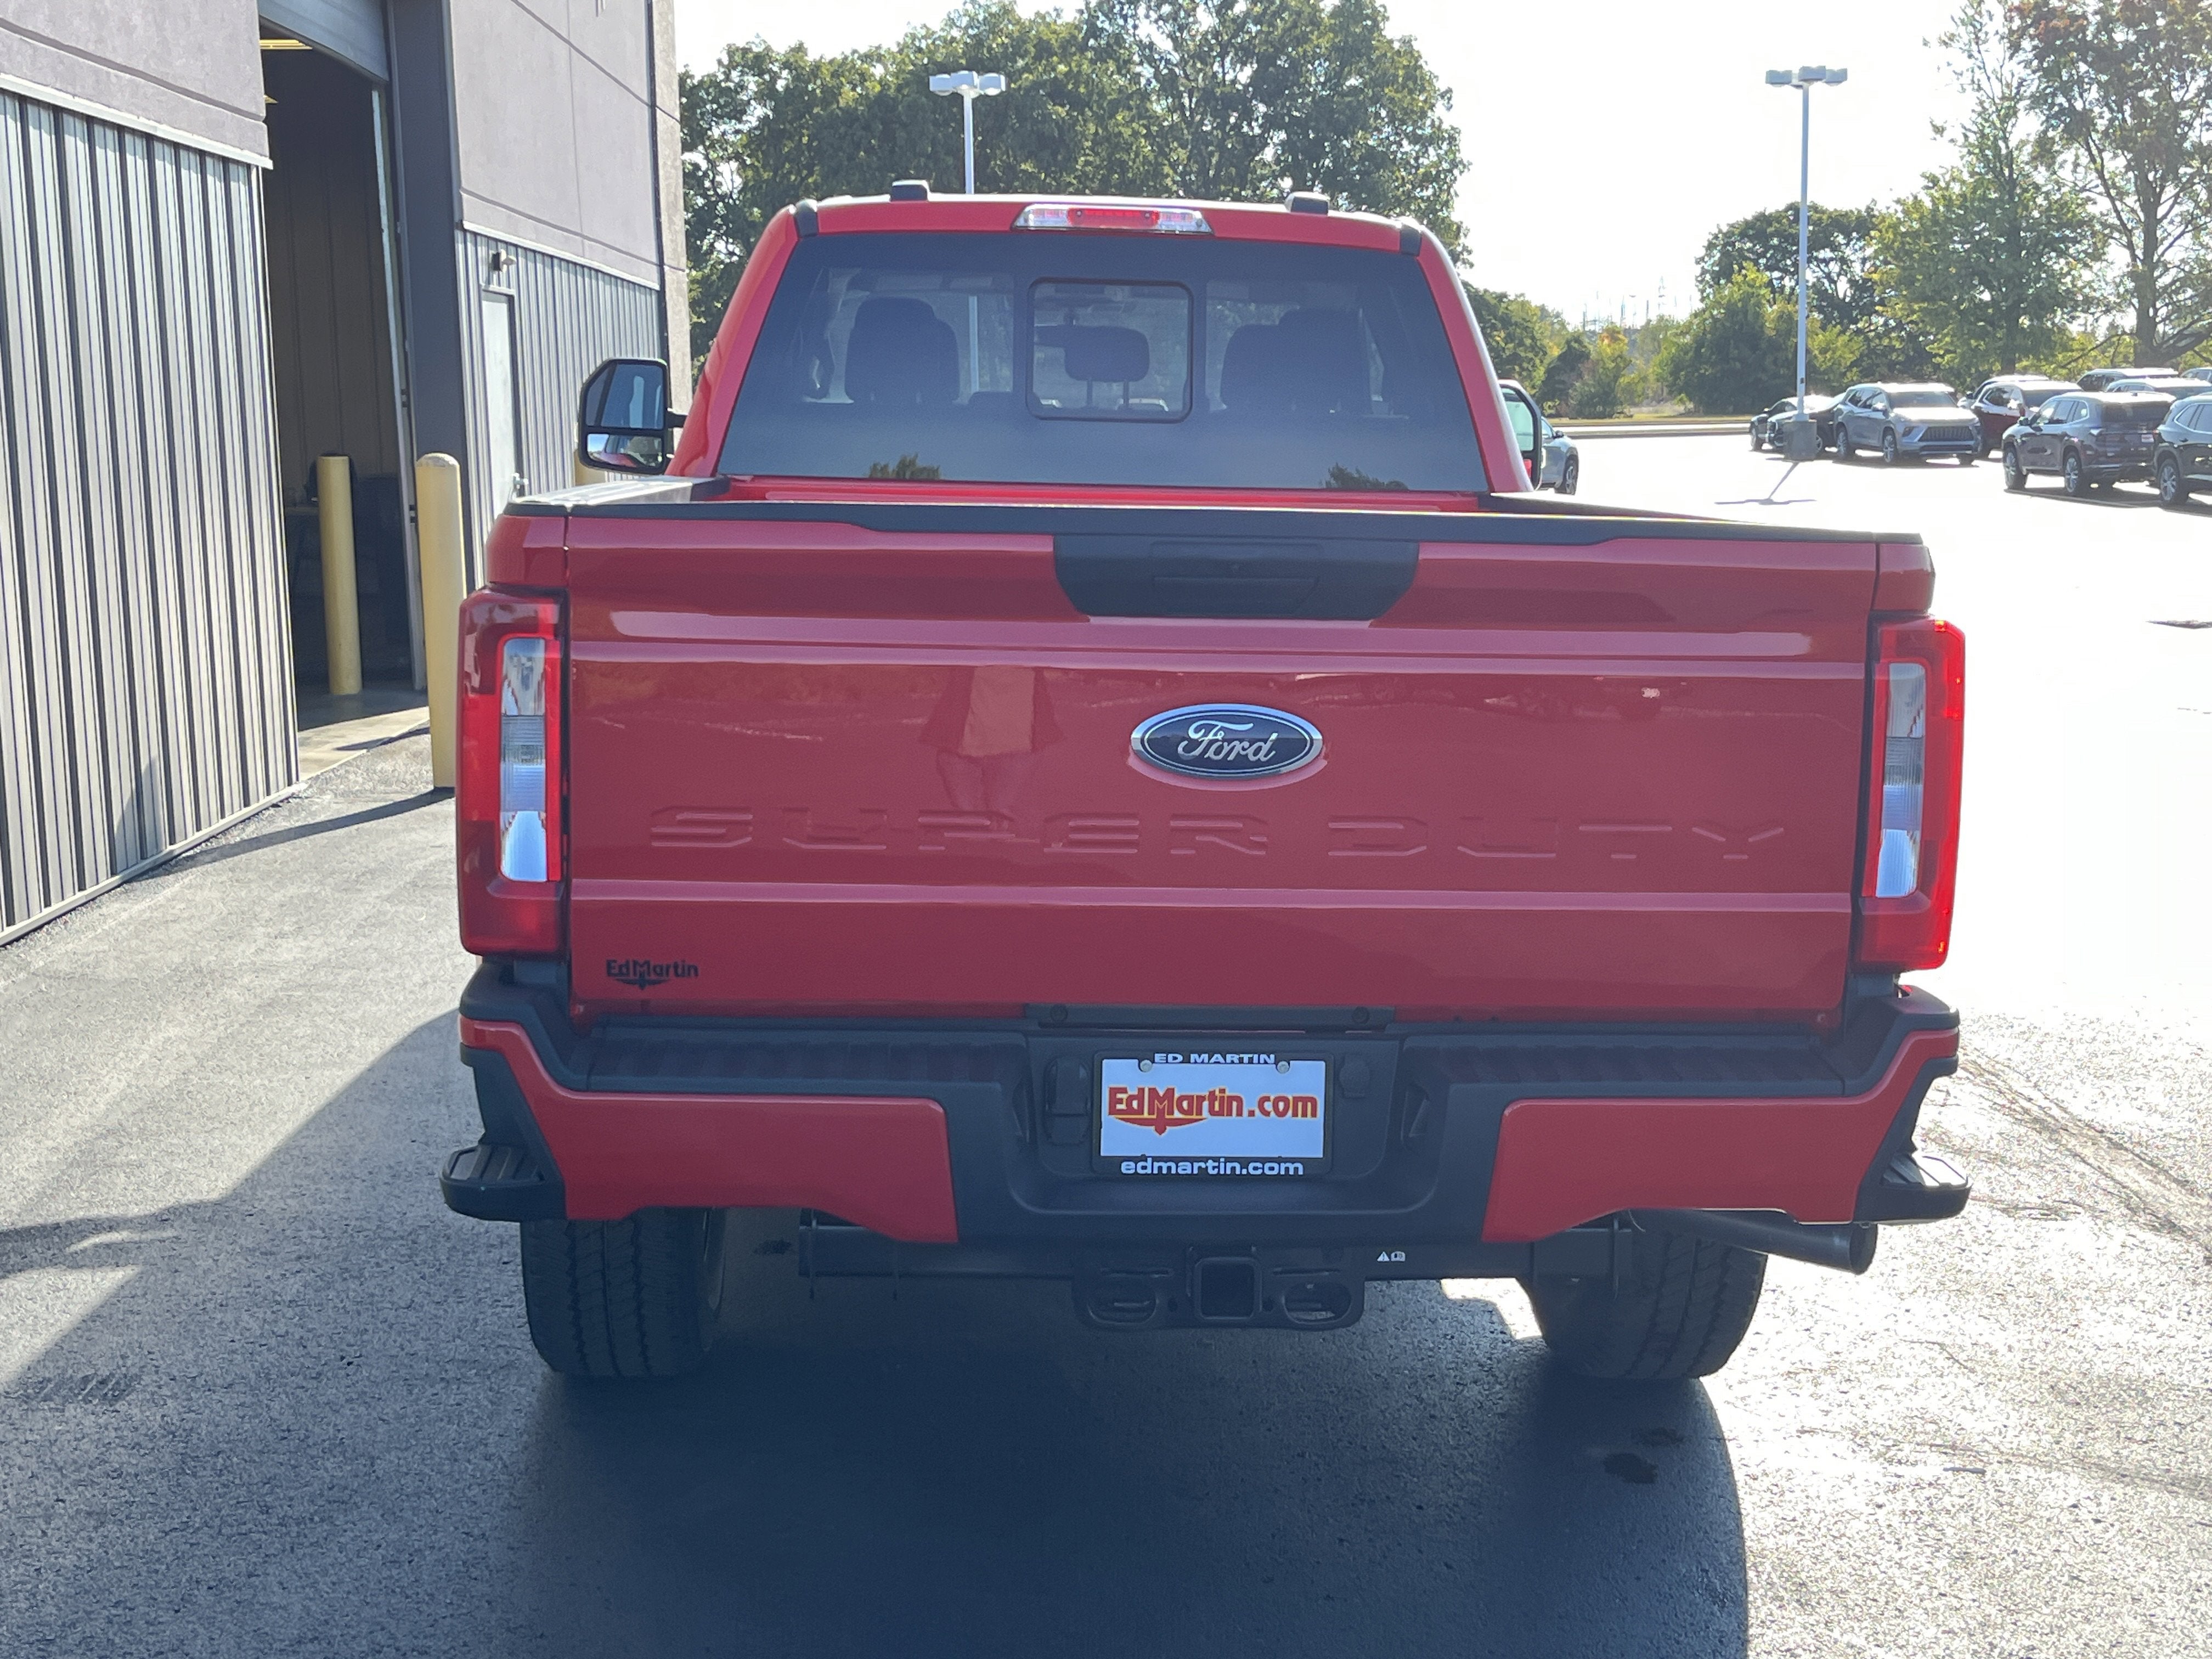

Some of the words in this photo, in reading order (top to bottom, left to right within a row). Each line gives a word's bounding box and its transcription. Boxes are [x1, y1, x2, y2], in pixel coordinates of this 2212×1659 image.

[1177, 720, 1278, 761] Ford
[650, 806, 1267, 854] SUPER
[1327, 815, 1785, 860] DUTY
[606, 960, 699, 983] EdMartin
[1154, 1053, 1183, 1064] ED
[1189, 1053, 1276, 1064] MARTIN
[1107, 1086, 1318, 1126] EdMartin.com
[1120, 1157, 1304, 1176] edmartin.com
